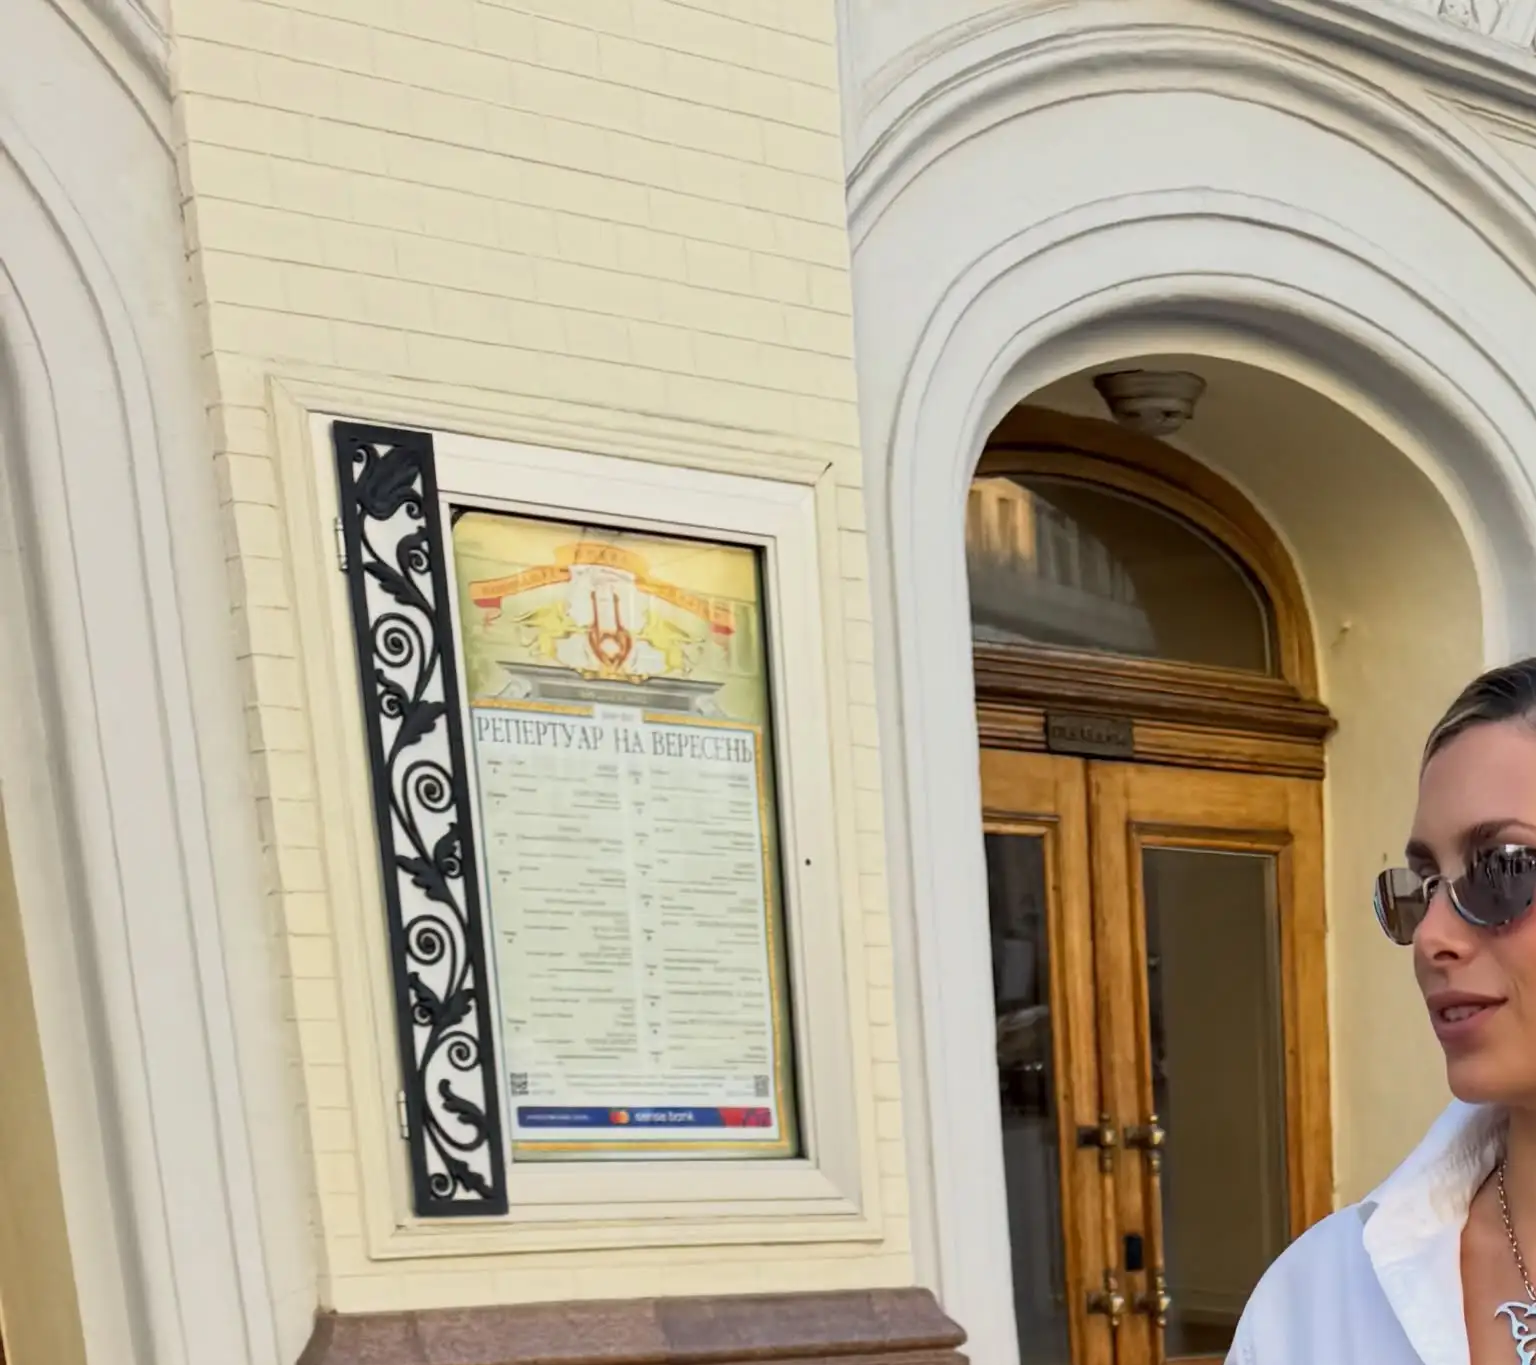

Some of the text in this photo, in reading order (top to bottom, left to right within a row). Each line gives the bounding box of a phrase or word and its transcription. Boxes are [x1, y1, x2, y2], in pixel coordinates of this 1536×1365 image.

[475, 715, 754, 764] РЕПЕРТУАР НА ВЕРЕСЕНЬ
